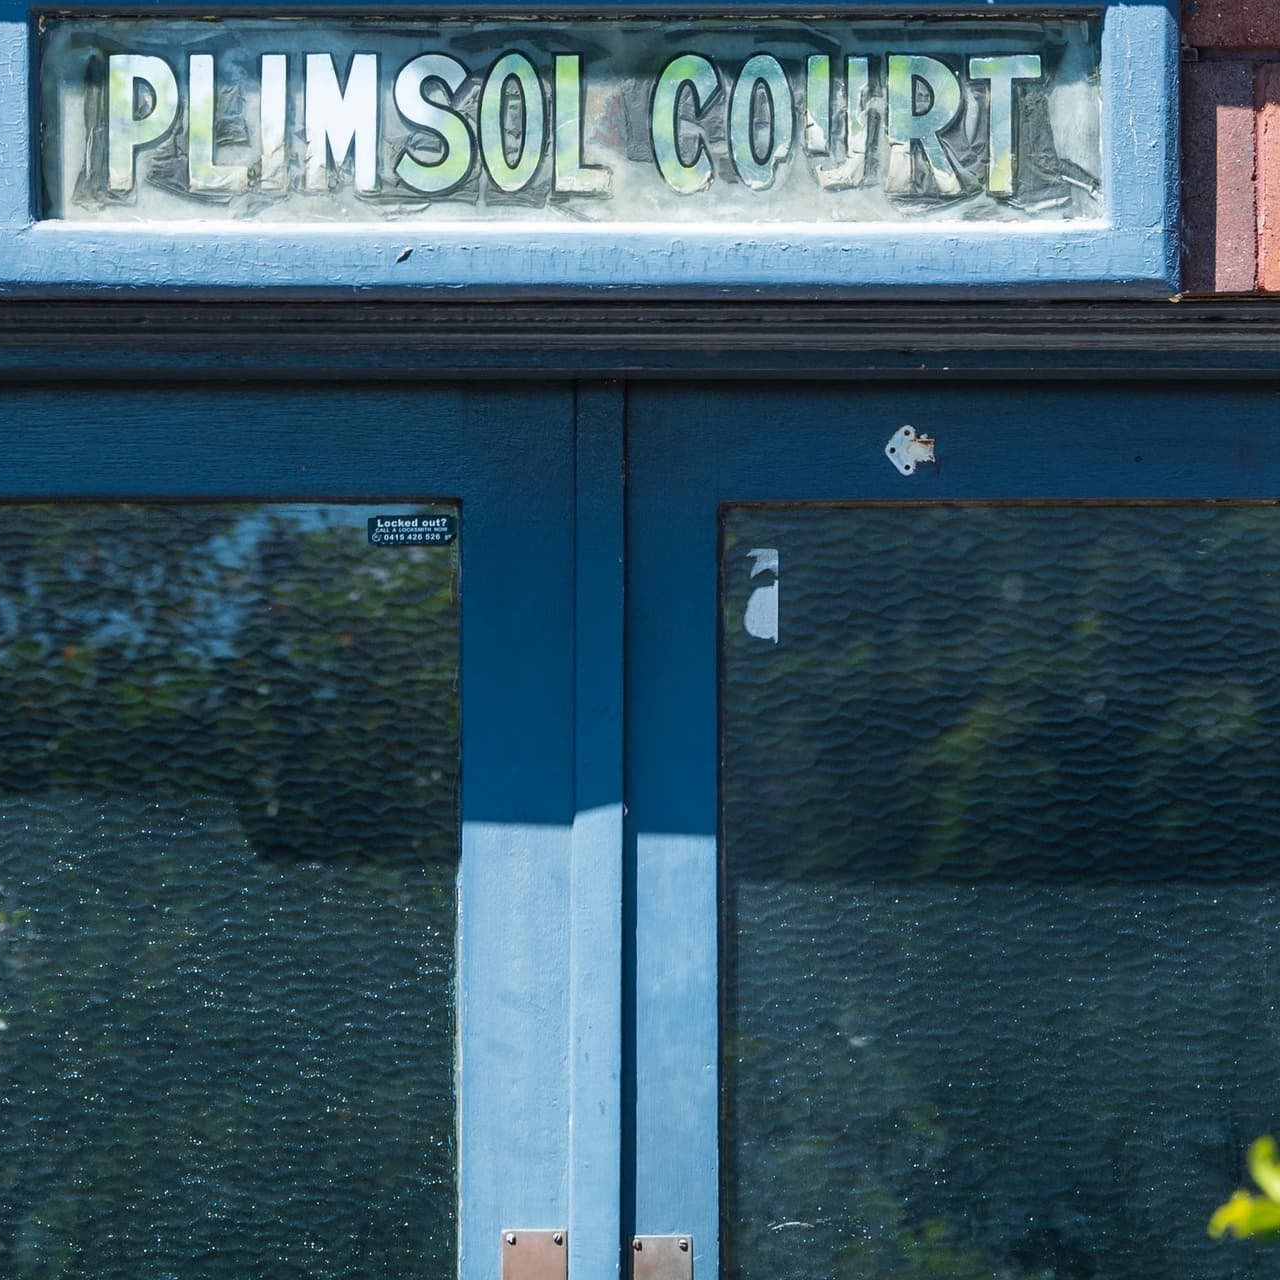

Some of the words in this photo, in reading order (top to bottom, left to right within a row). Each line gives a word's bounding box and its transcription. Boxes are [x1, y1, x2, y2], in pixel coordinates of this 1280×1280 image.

[108, 51, 614, 194] PLIMSOL
[650, 51, 1043, 195] COURT
[377, 518, 418, 528] Locked
[422, 518, 447, 528] out?
